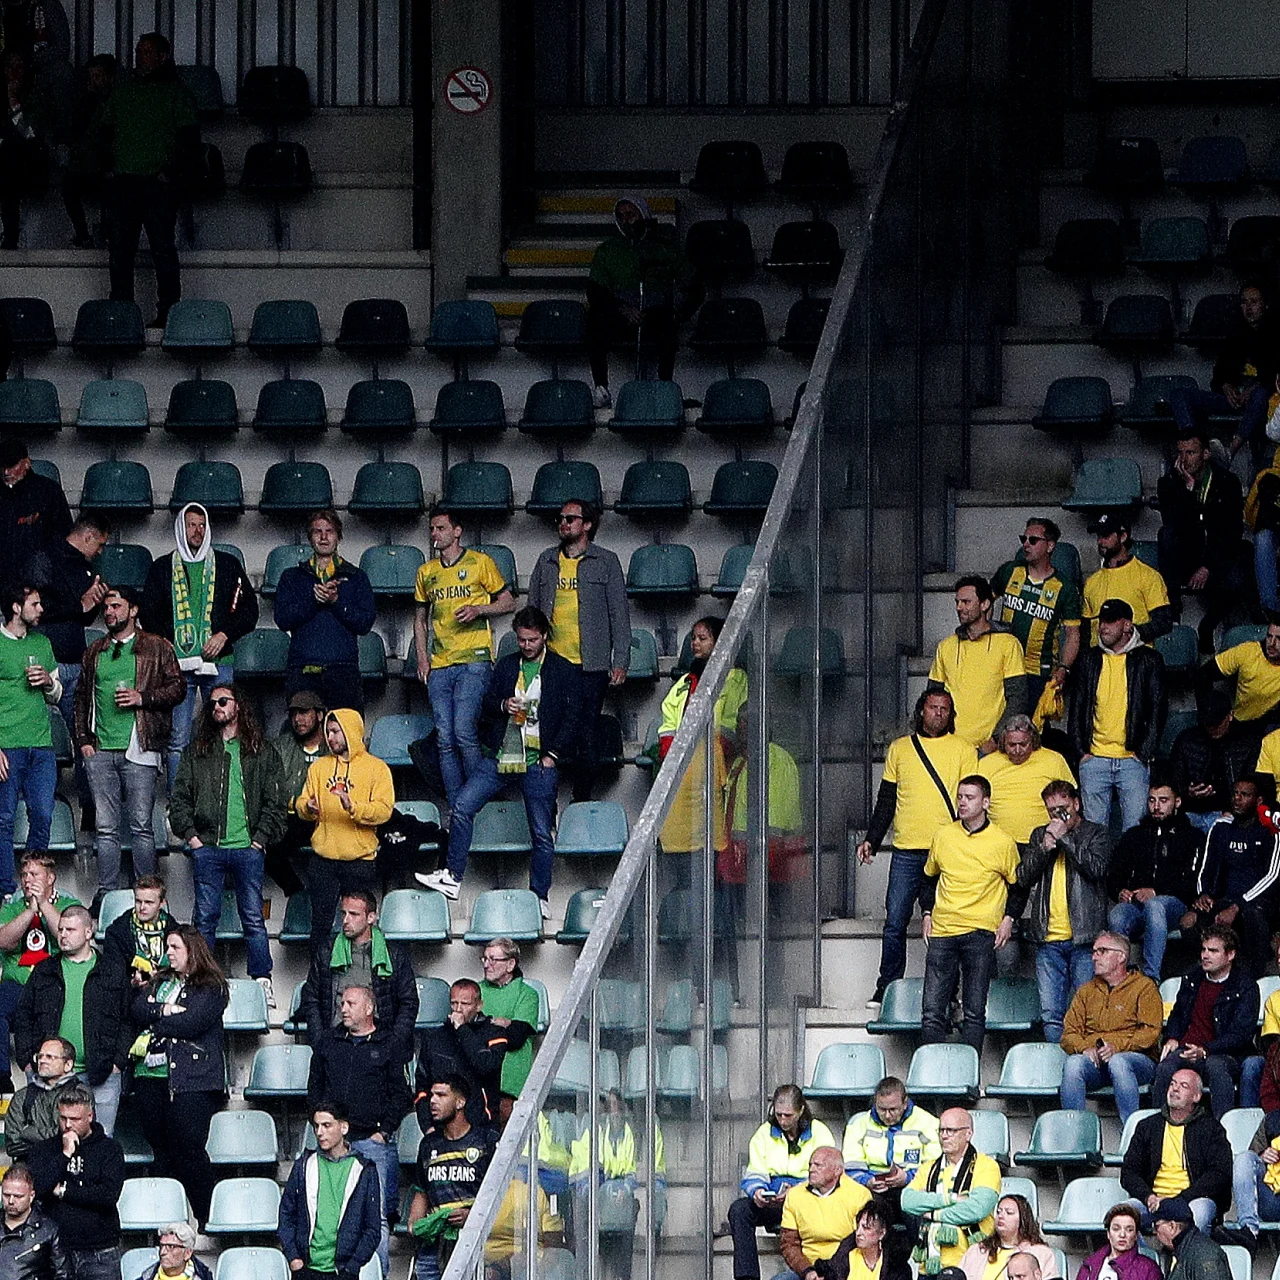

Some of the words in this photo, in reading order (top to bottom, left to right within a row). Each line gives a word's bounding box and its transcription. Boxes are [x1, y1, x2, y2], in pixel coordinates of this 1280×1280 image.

[1023, 600, 1055, 621] JEANS
[428, 1165, 448, 1182] CARS
[448, 1165, 476, 1182] JEANS
